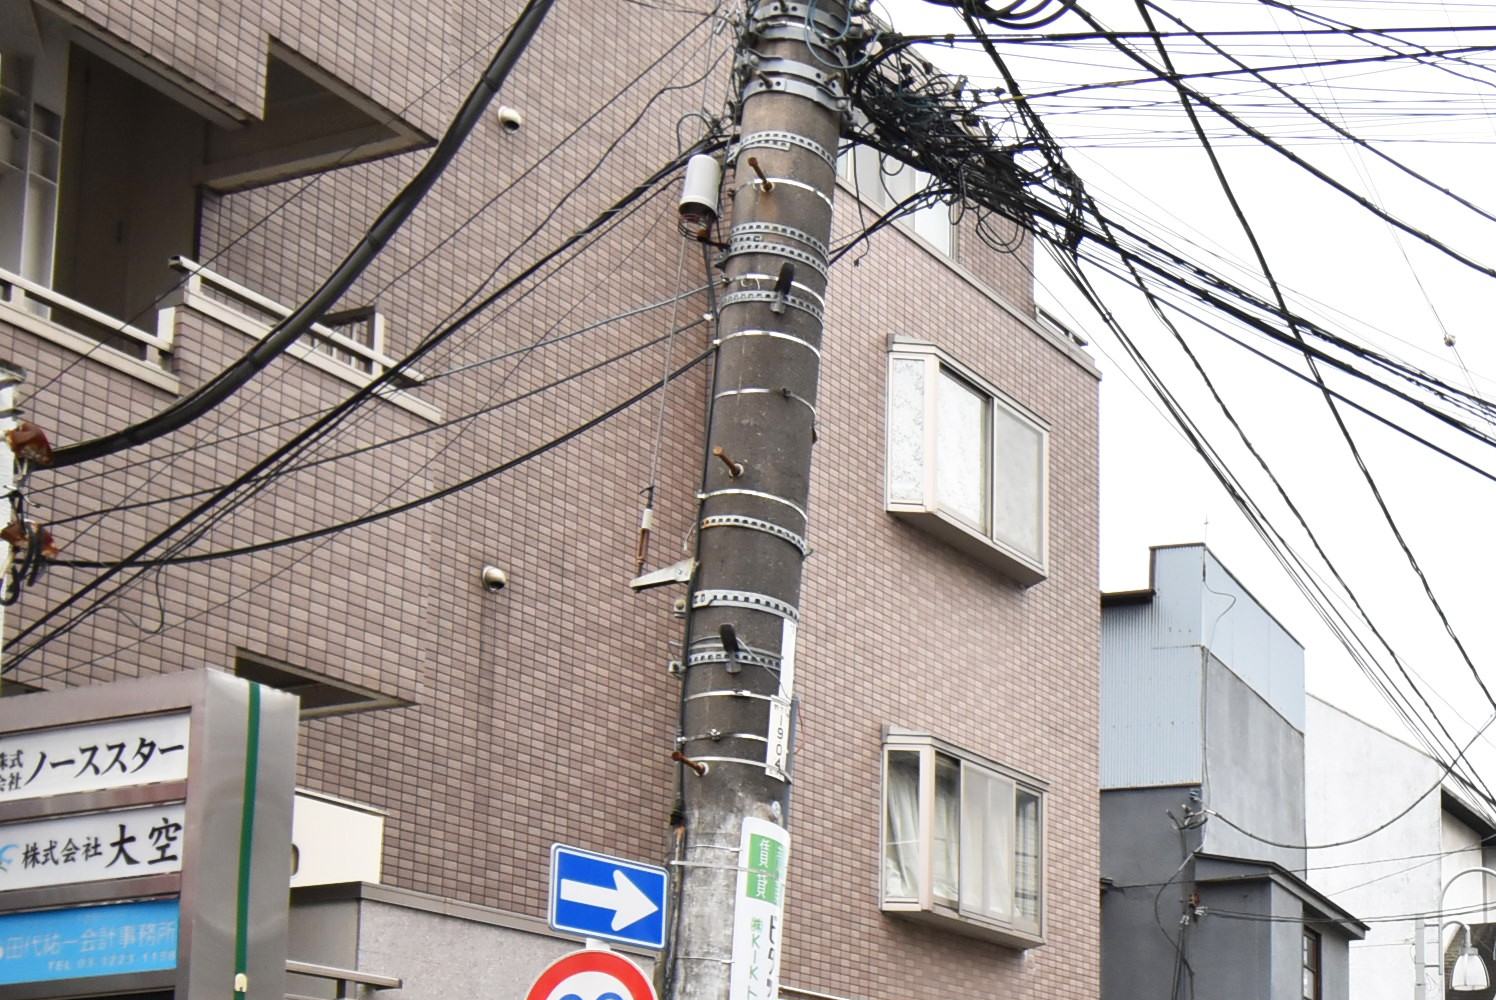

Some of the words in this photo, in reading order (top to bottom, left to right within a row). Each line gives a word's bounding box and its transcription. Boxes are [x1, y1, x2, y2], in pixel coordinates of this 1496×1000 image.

[24, 736, 186, 786] ノーススター
[22, 835, 104, 871] 株式会社
[105, 816, 183, 869] 大空
